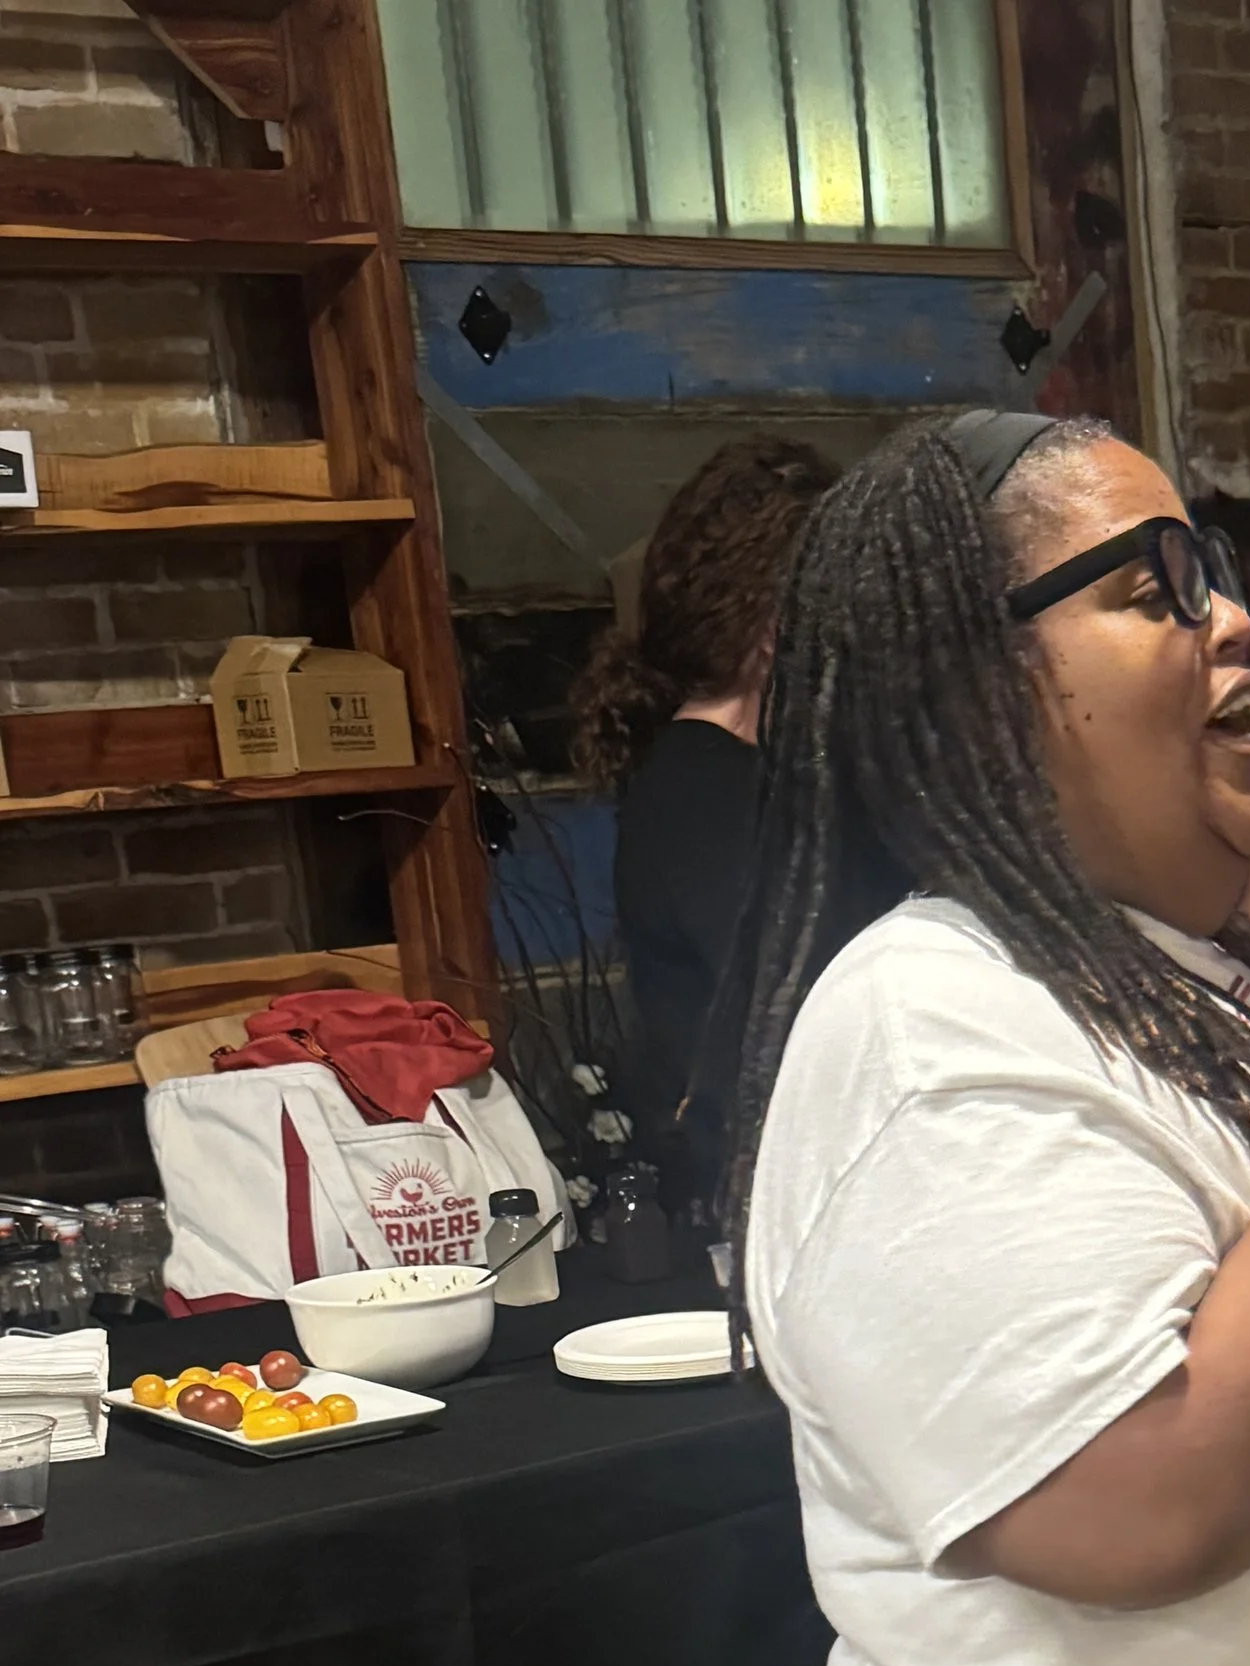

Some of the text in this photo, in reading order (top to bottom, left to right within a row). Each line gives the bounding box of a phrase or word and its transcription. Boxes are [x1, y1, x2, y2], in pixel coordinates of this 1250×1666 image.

[237, 726, 277, 740] FRAGILE
[329, 725, 374, 737] FRAGILE
[369, 1202, 440, 1219] lveston's
[346, 1210, 481, 1250] RMERS
